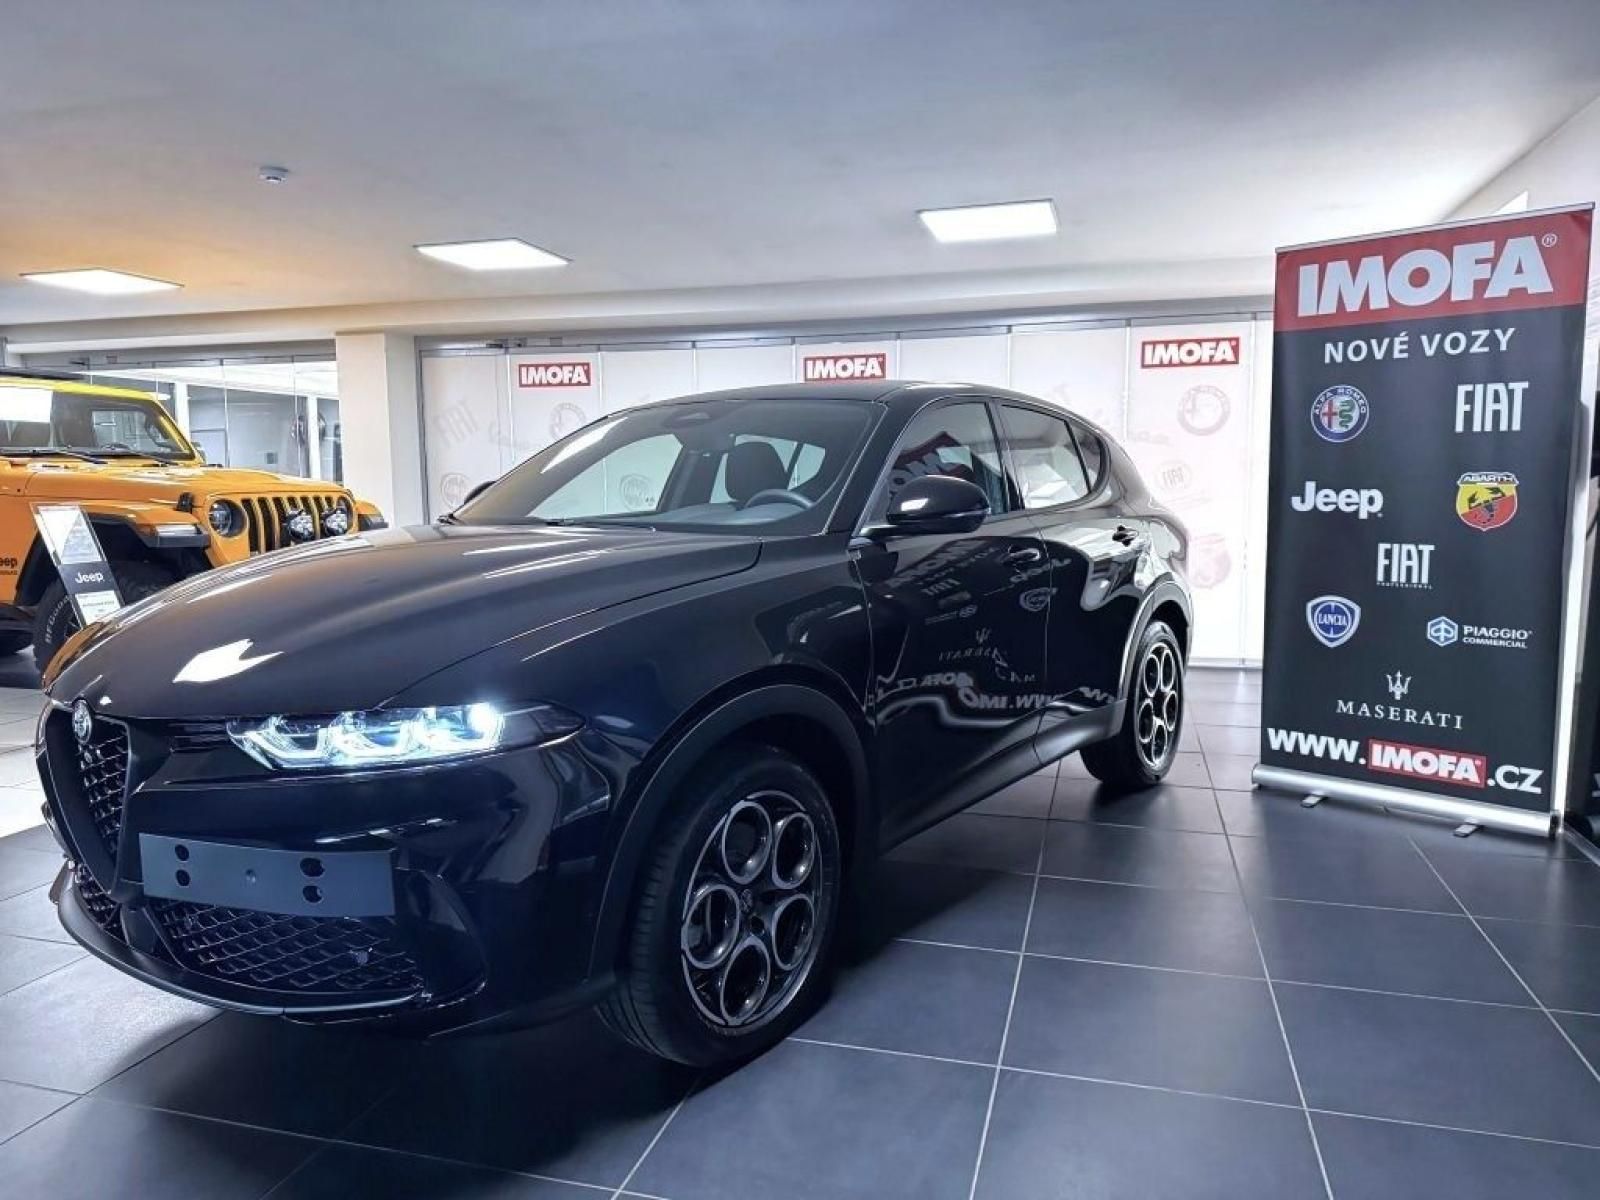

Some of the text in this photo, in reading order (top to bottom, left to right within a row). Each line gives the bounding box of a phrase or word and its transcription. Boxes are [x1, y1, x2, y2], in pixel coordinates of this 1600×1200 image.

[1298, 236, 1553, 317] IMOFA
[1144, 340, 1237, 365] IMOFA
[1324, 327, 1517, 364] NOVÉ VOZY
[521, 364, 589, 385] IMOFA
[807, 357, 884, 379] IMOFA
[1455, 381, 1529, 433] FIAT
[1291, 480, 1384, 520] Jeep
[1377, 543, 1436, 585] FIAT
[75, 571, 104, 584] Jeep
[1318, 612, 1348, 626] LANCIA
[1462, 636, 1528, 649] COMMERCIAL
[1463, 624, 1529, 640] PIAGGIO
[1336, 699, 1463, 730] MASERATI
